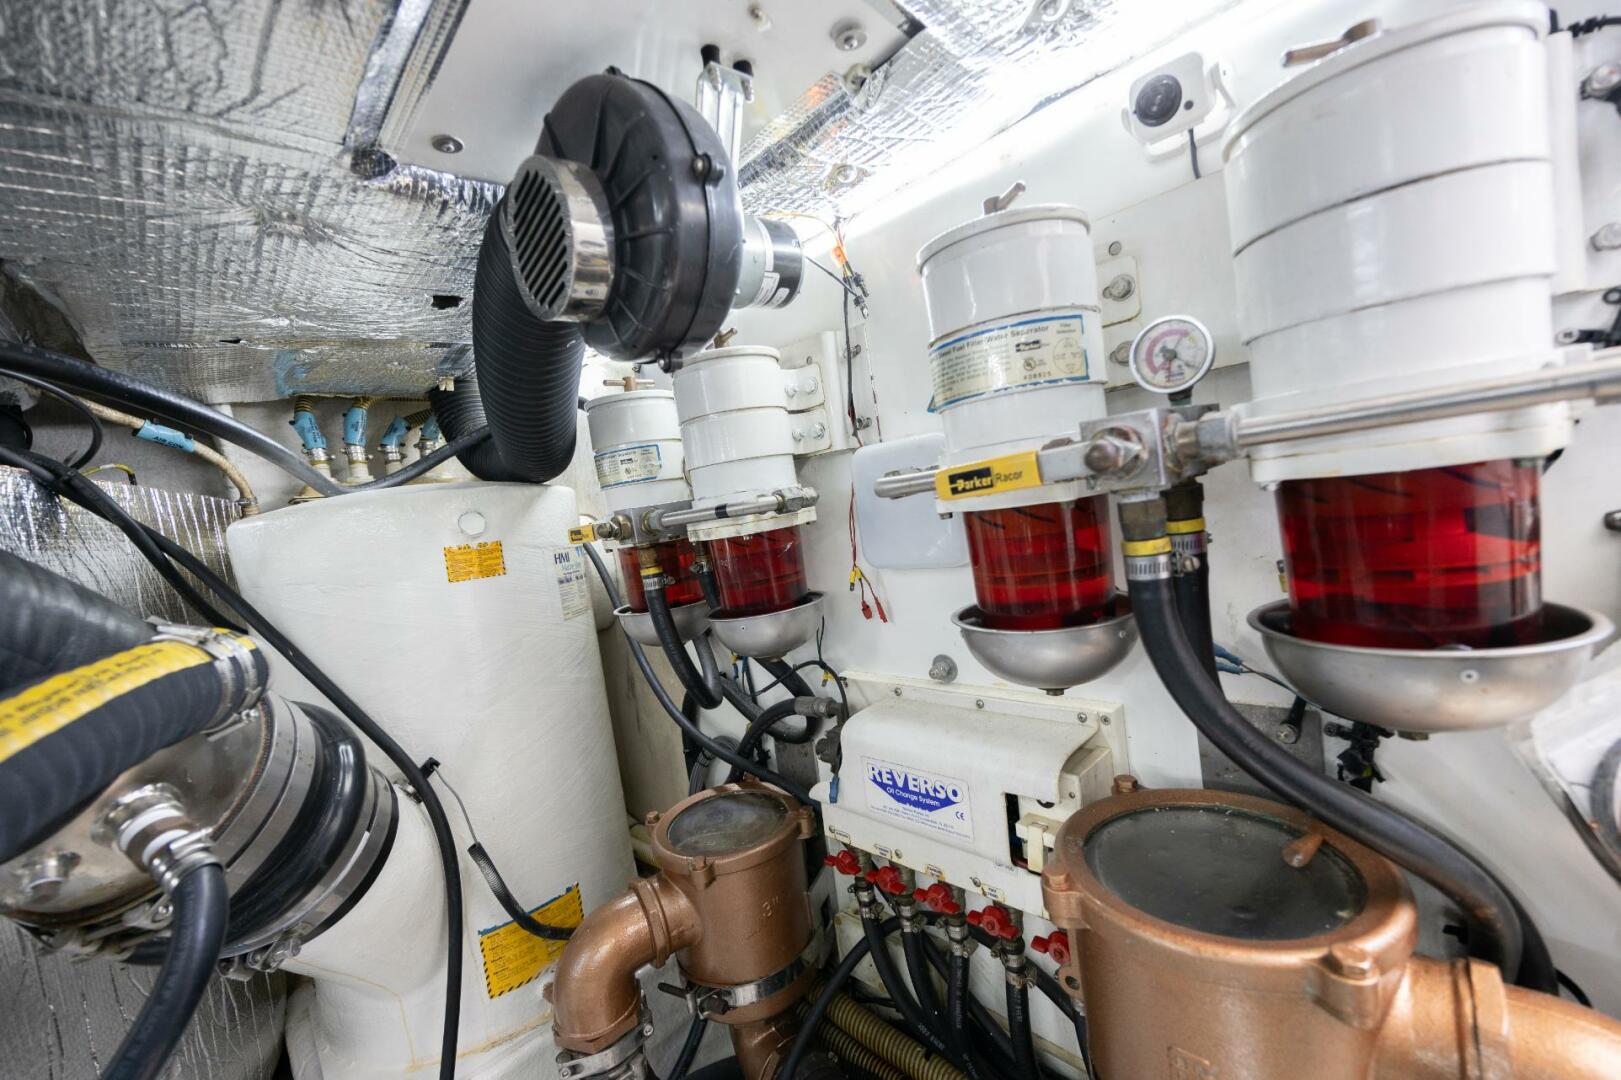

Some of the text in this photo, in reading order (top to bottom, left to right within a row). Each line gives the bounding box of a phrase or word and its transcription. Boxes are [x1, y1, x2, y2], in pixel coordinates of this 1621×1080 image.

[954, 470, 1023, 491] Parker Racor
[868, 764, 964, 803] REVERSO
[919, 795, 940, 807] System
